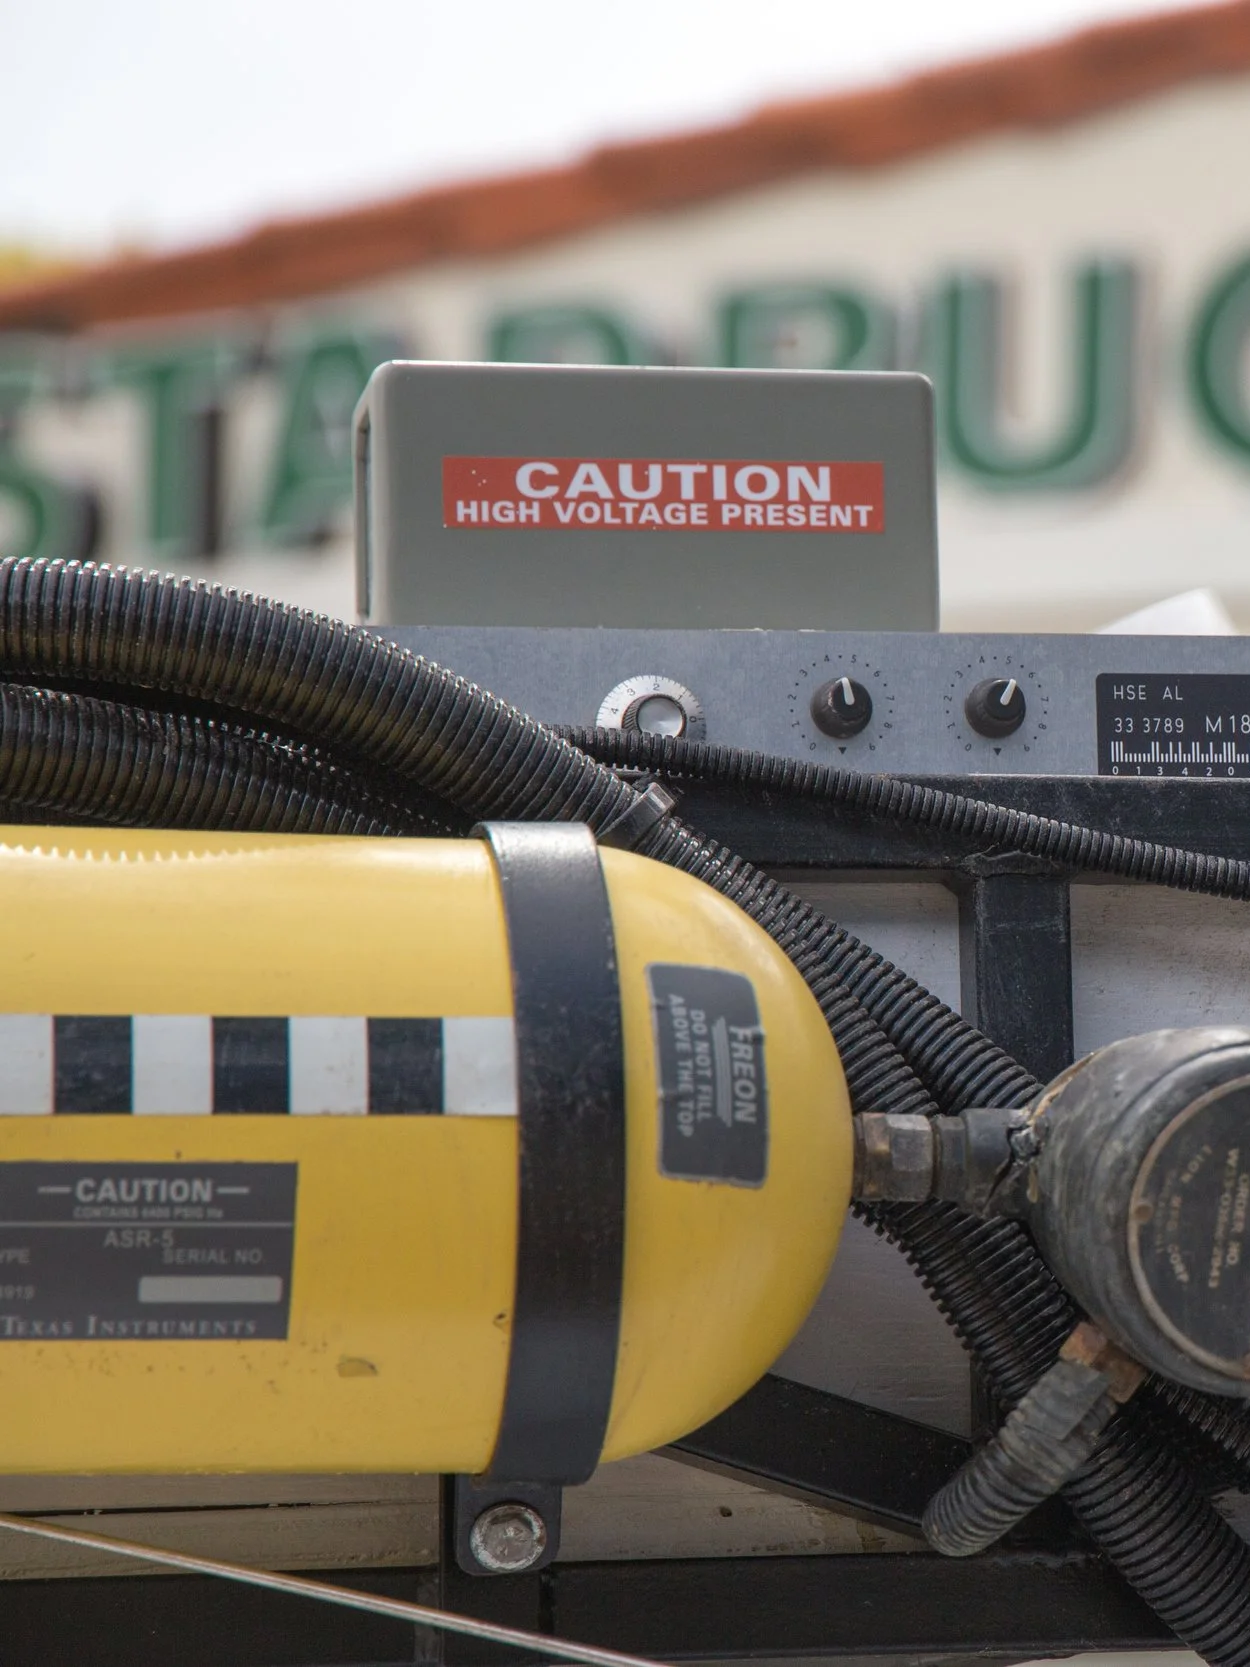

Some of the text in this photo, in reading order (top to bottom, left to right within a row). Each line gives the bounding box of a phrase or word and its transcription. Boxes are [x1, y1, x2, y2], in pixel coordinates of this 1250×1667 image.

[515, 461, 831, 502] CAUTION
[456, 501, 874, 528] HIGH VOLTAGE PRESENT
[627, 688, 636, 696] 3
[653, 683, 660, 691] 2
[689, 715, 697, 723] 0
[1113, 684, 1183, 700] HSE AL
[1114, 717, 1134, 733] 33
[1142, 717, 1184, 733] 3789
[1112, 766, 1119, 776] 0
[1136, 766, 1141, 776] 1
[1157, 766, 1163, 776] 3
[1182, 766, 1189, 776] 4
[1206, 766, 1213, 776] 2
[1228, 766, 1235, 776] 0
[669, 994, 694, 1137] ABOVE THE TOP
[690, 1009, 712, 1121] DO NOT FILL
[729, 1025, 758, 1122] FREON
[75, 1178, 213, 1202] CAUTION
[1231, 1173, 1250, 1233] ORDER
[104, 1230, 174, 1248] ASR-5
[162, 1249, 228, 1265] SERIAL
